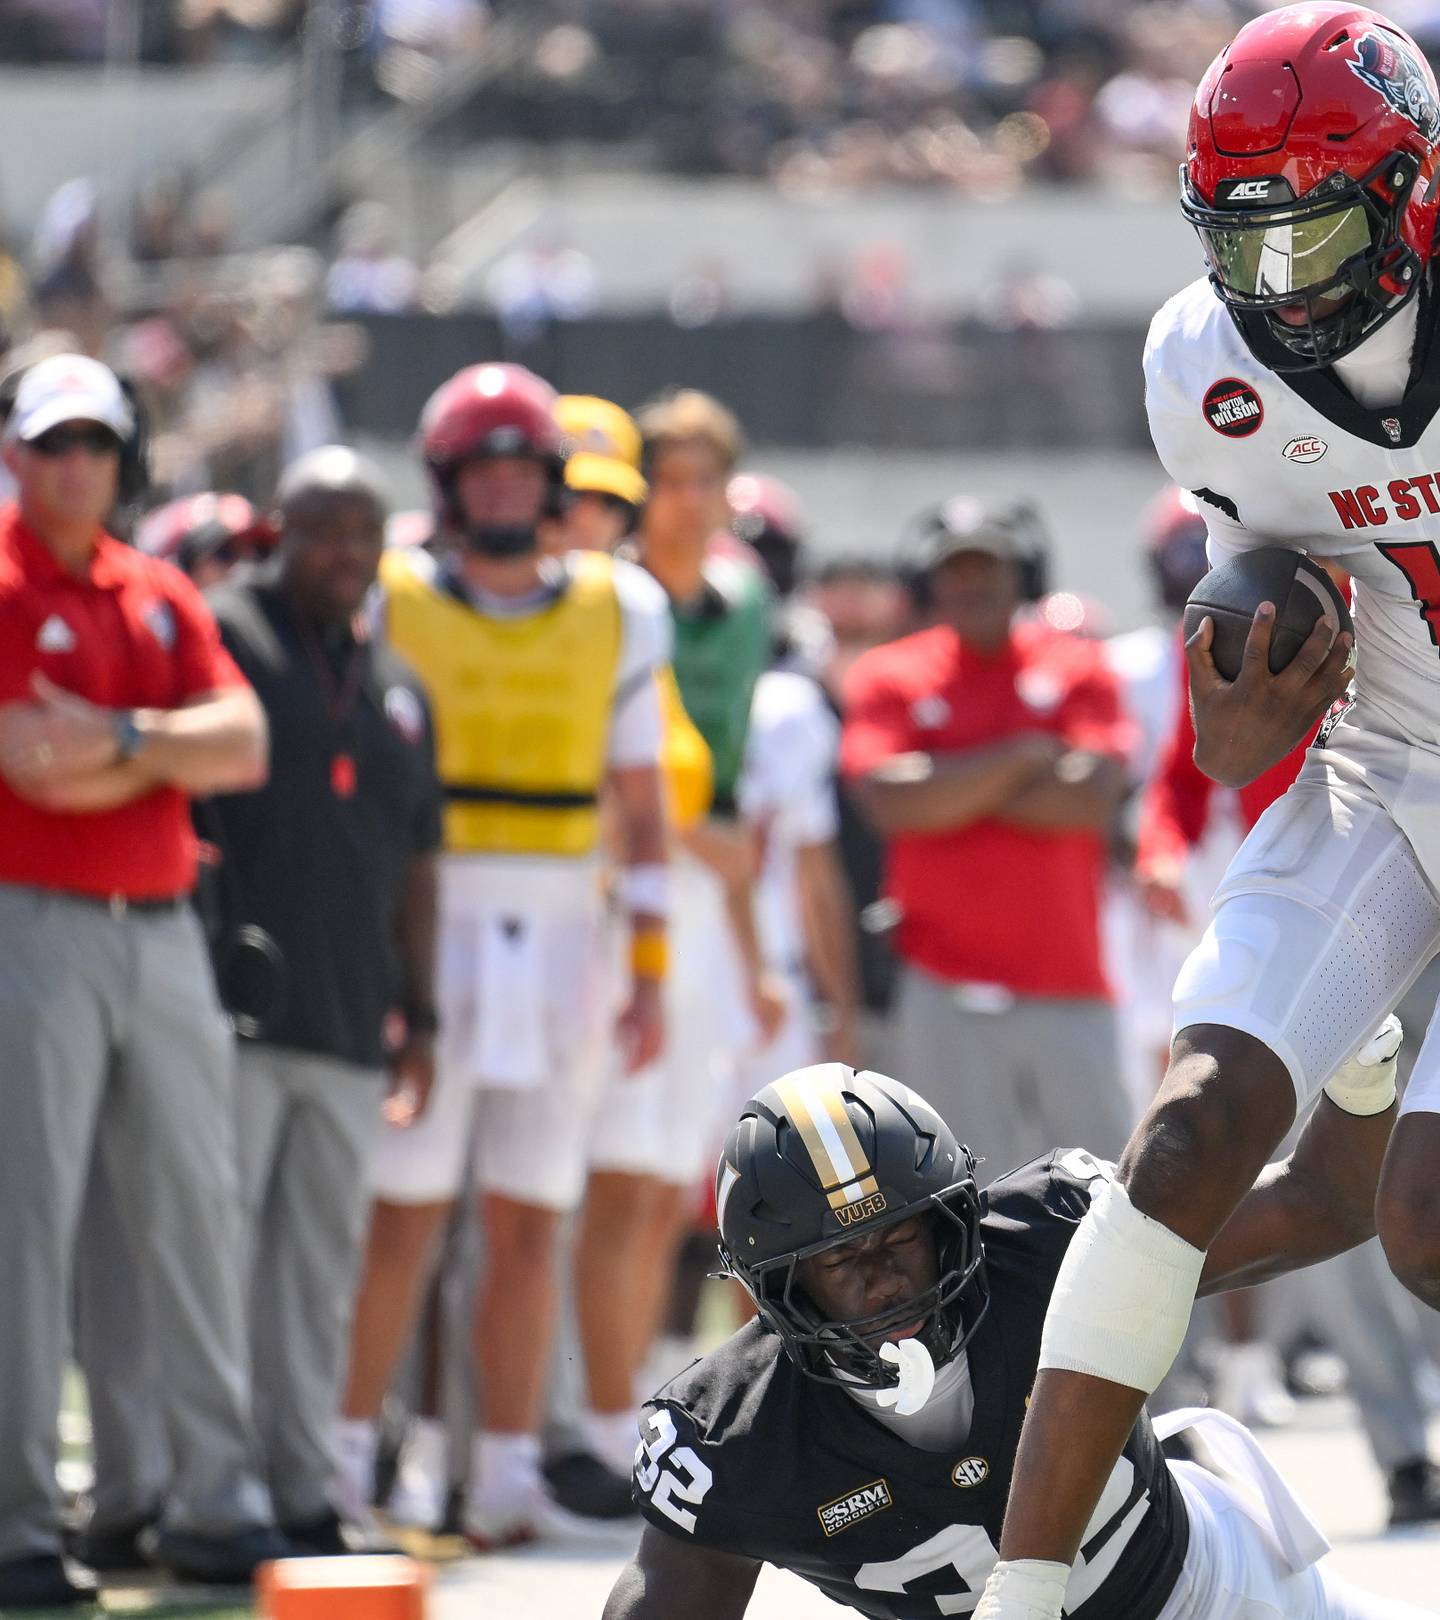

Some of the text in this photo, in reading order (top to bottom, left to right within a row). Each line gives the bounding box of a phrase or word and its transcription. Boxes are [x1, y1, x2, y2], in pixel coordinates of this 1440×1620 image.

[1230, 181, 1271, 196] ACC
[1211, 400, 1260, 427] WILSON
[1218, 395, 1246, 412] PAYTON
[1290, 441, 1321, 455] ACC
[1328, 485, 1389, 530] NC
[834, 1192, 887, 1226] VUFB
[954, 1459, 986, 1486] SEC
[827, 1498, 889, 1532] CONCRETE
[833, 1485, 887, 1520] SRM
